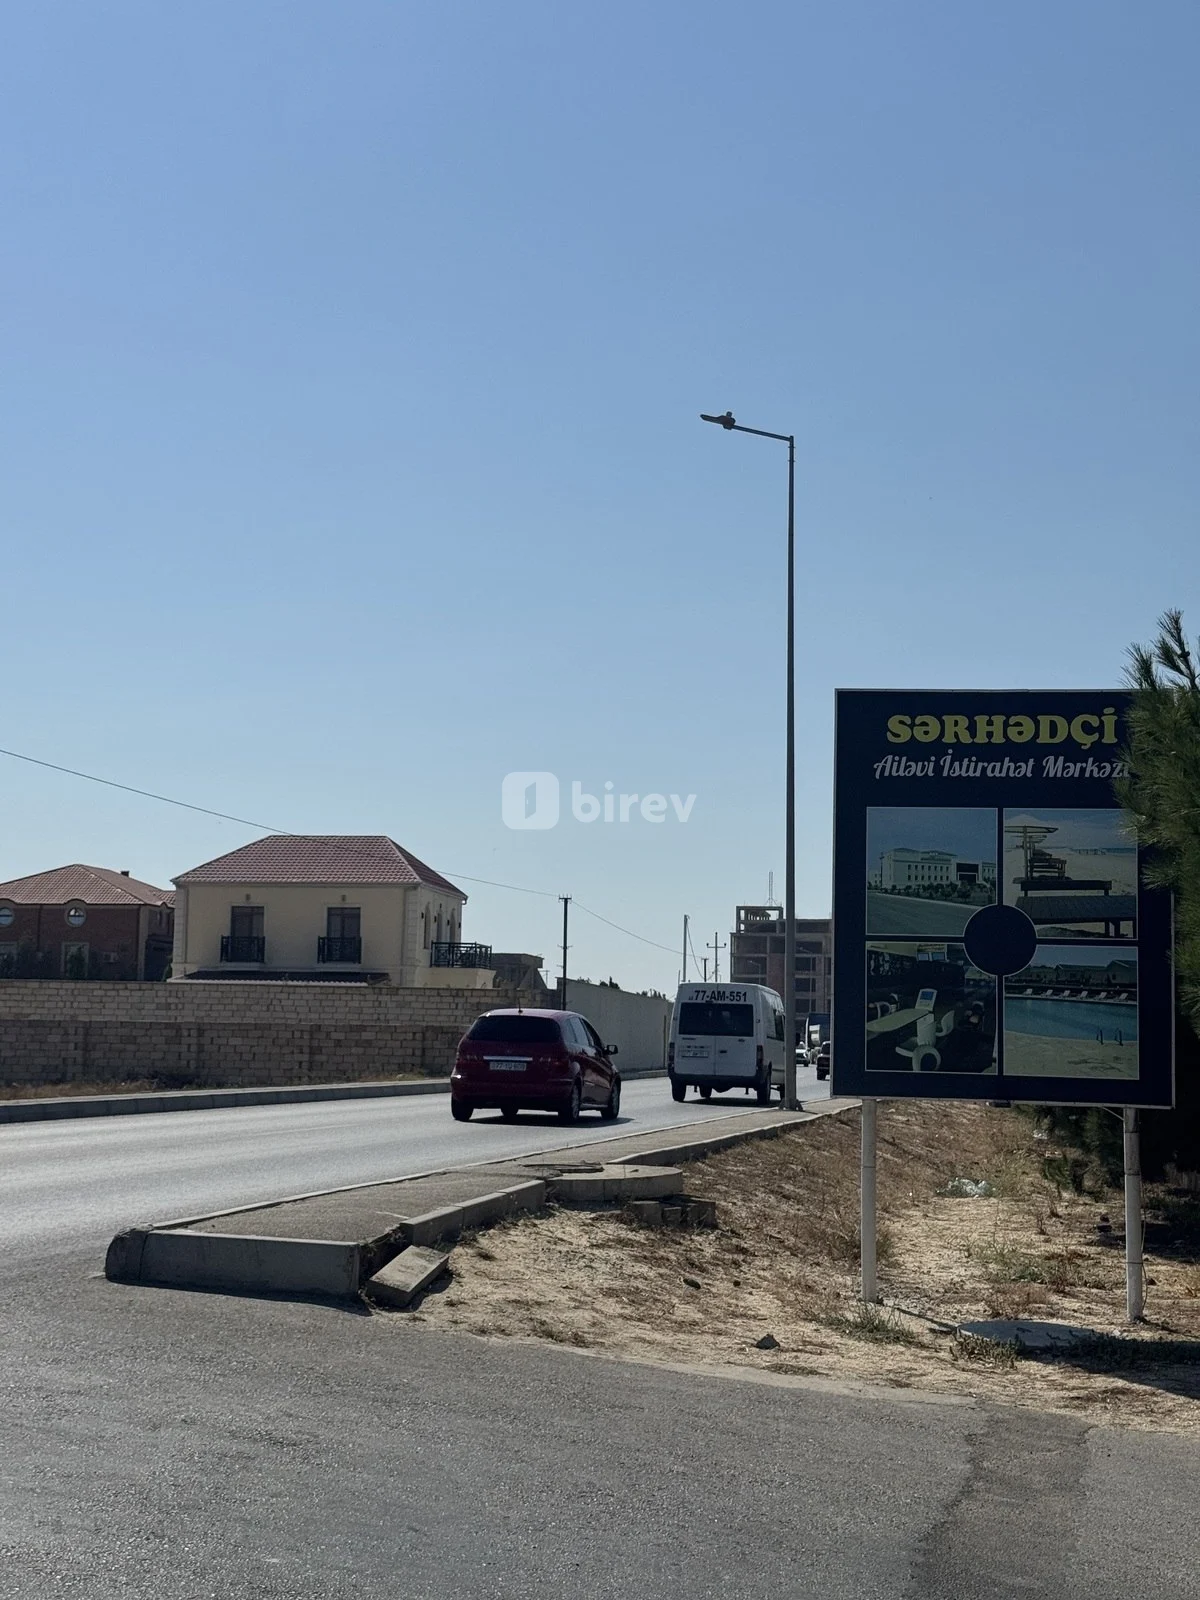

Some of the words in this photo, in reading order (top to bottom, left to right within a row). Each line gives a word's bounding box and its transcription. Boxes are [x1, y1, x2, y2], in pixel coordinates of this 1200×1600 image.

[886, 707, 1118, 750] SƏRHƏDÇİ
[873, 754, 935, 779] Ailəvi
[940, 748, 1036, 779] İstirahət
[694, 989, 748, 1003] 77-AM-551
